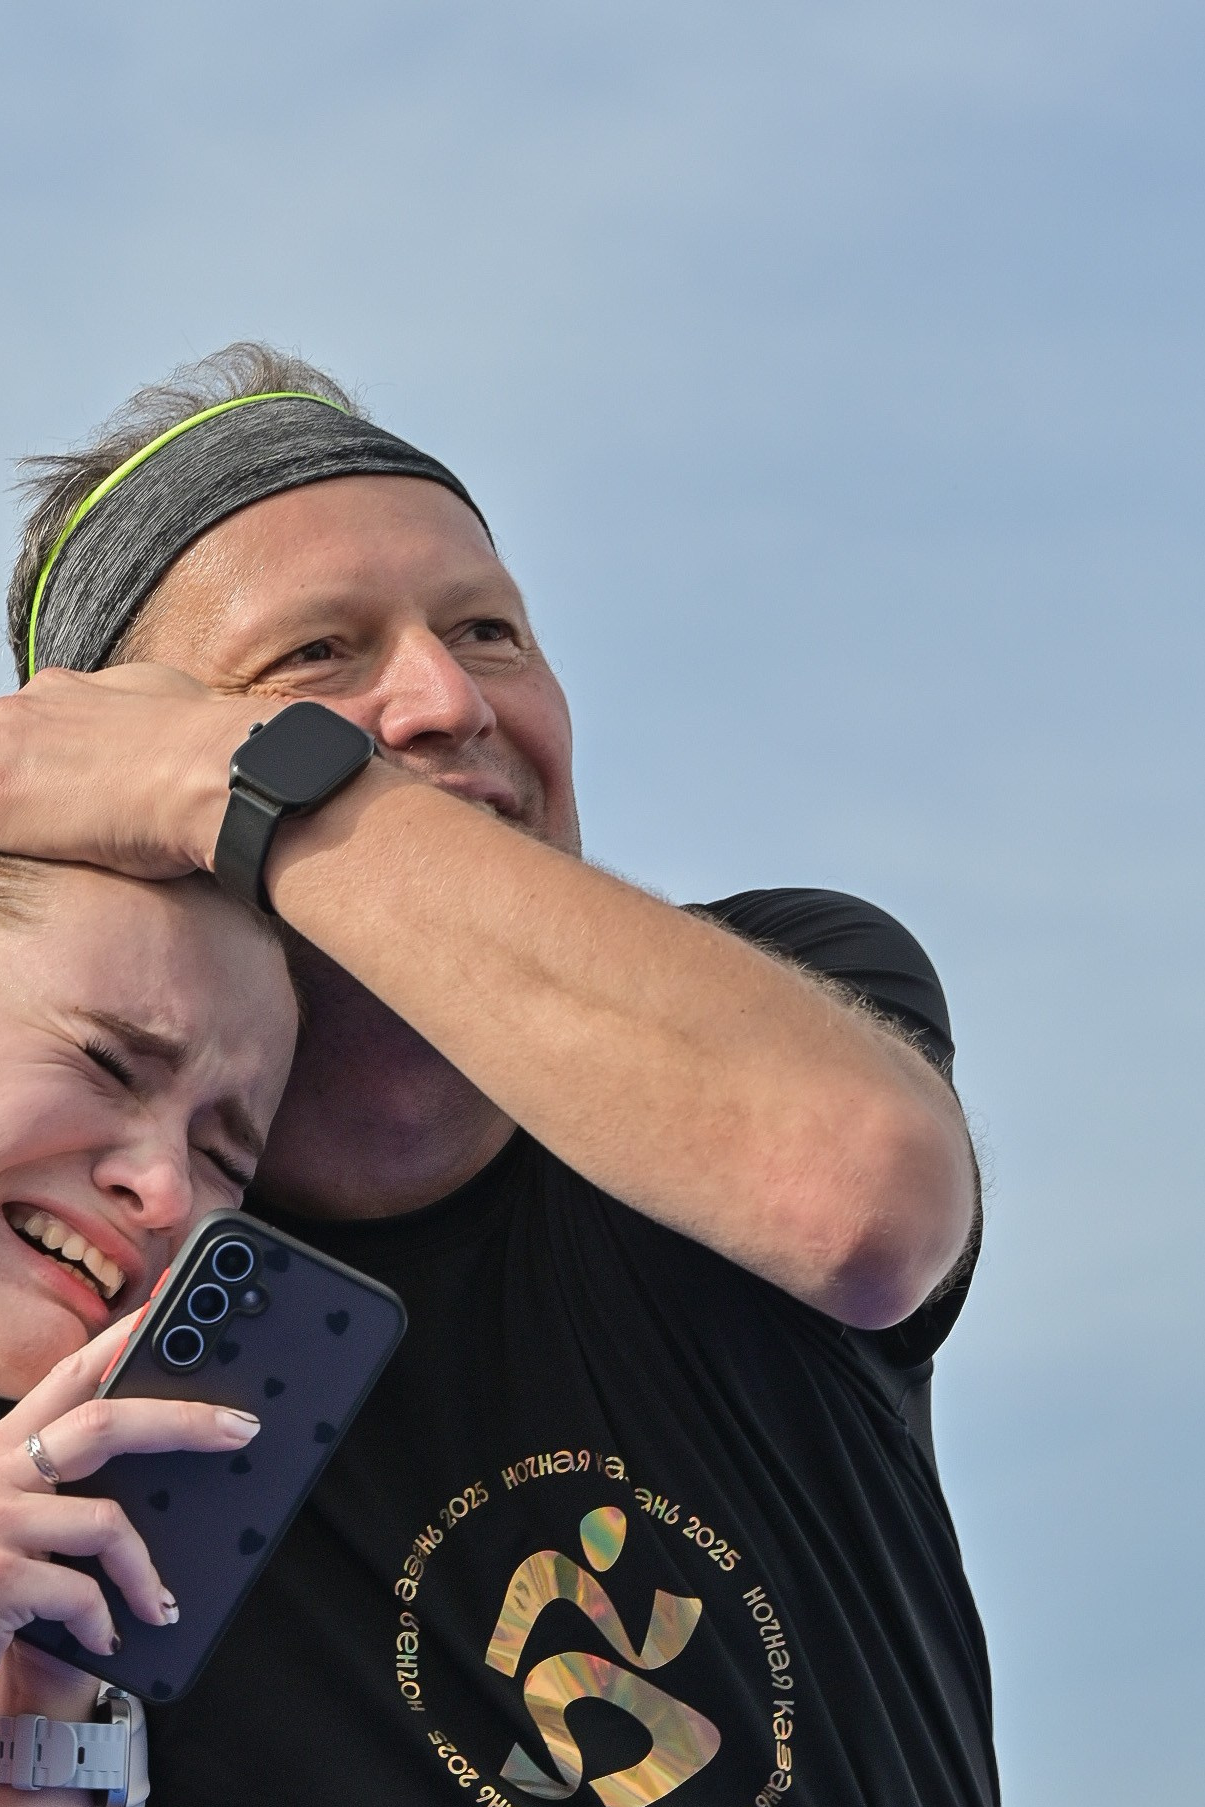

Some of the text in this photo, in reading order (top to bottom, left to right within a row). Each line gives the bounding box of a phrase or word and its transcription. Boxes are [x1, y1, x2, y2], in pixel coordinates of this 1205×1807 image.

[439, 1480, 490, 1530] 2025
[682, 1516, 742, 1571] 2025
[427, 1730, 480, 1788] 2025
